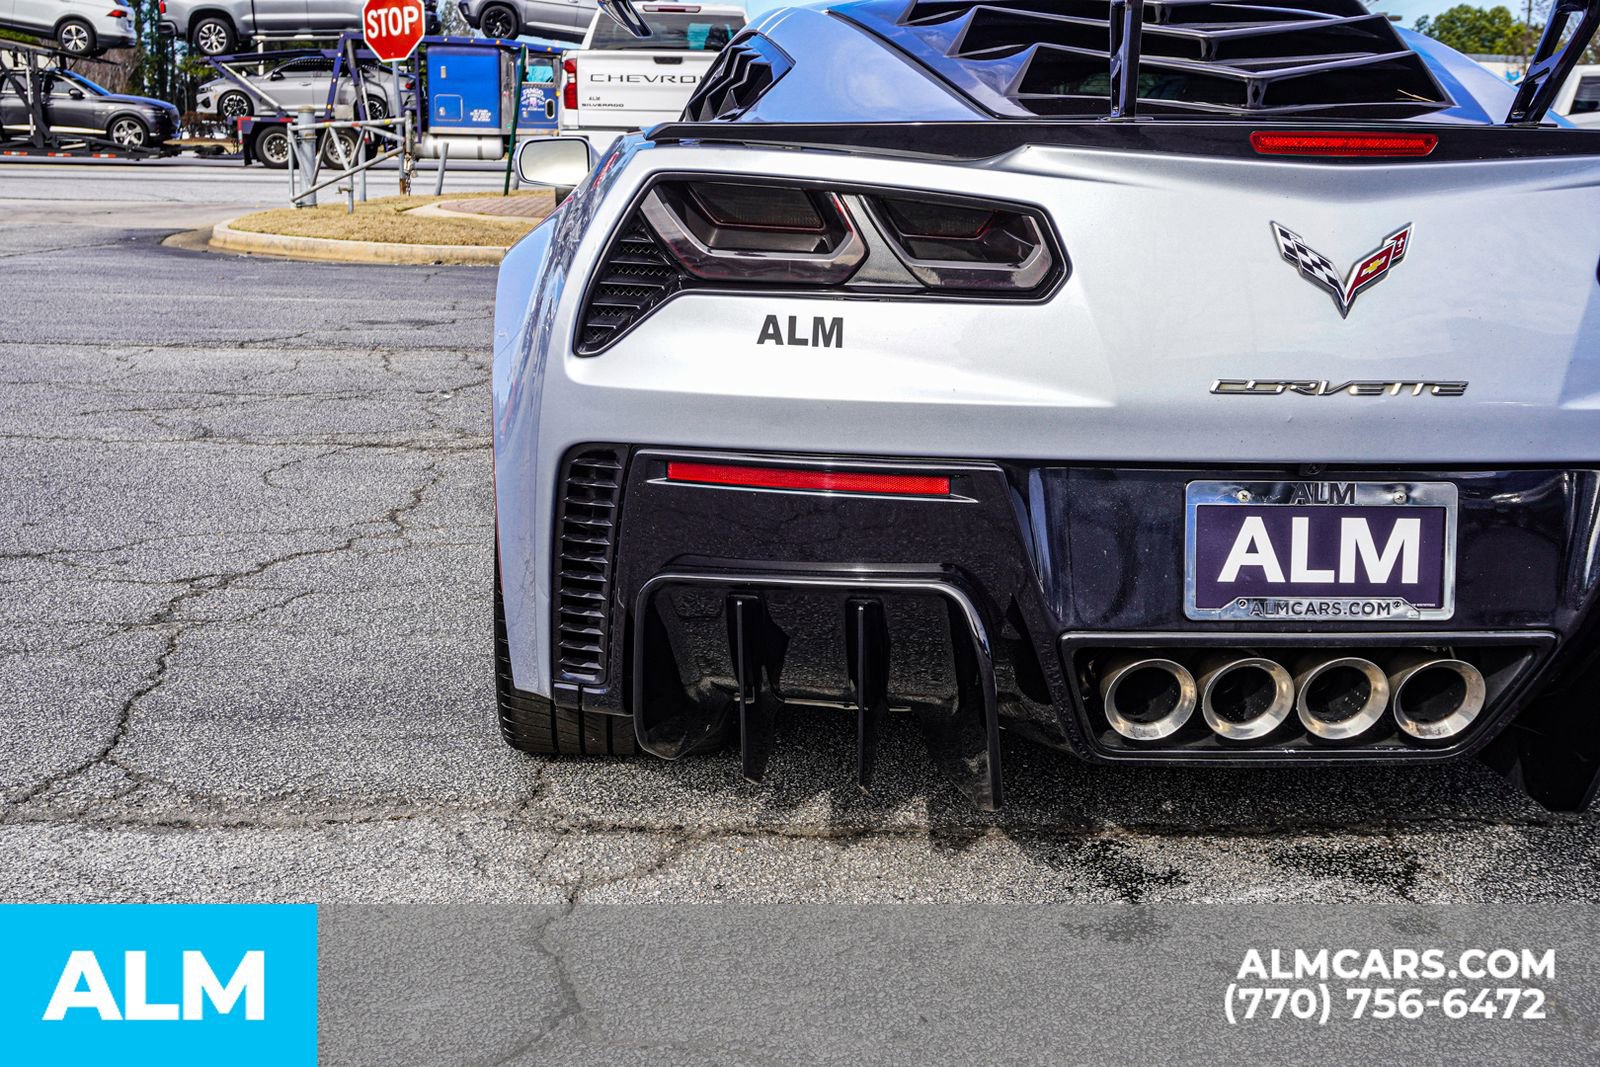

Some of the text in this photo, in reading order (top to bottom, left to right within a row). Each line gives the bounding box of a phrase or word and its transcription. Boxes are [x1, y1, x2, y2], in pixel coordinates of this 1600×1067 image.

[367, 6, 419, 39] STOP
[590, 74, 703, 83] CHEVRO
[756, 314, 844, 348] ALM
[1209, 379, 1469, 396] CORVETTE
[1289, 482, 1356, 504] ALM
[1216, 516, 1421, 584] ALM
[1250, 600, 1391, 616] ALMCARS.COM
